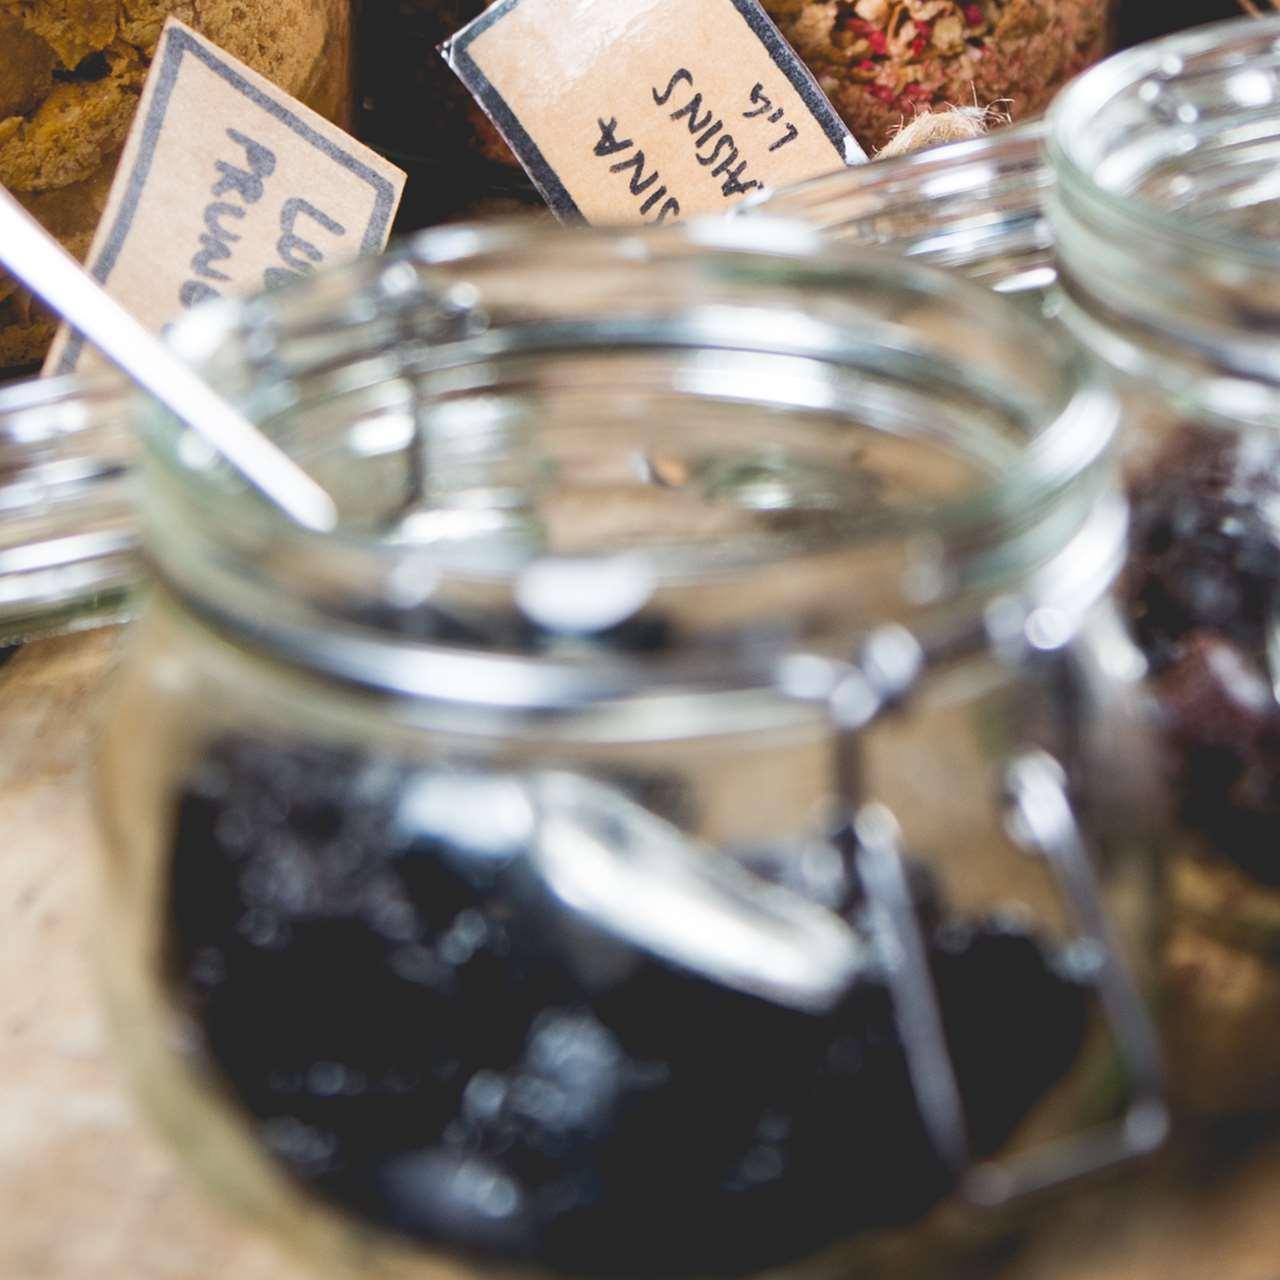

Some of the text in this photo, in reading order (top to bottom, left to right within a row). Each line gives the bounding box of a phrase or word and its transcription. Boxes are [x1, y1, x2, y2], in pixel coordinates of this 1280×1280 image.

[592, 116, 681, 222] SINA
[651, 67, 765, 198] AISINS
[164, 127, 277, 330] PRUNE
